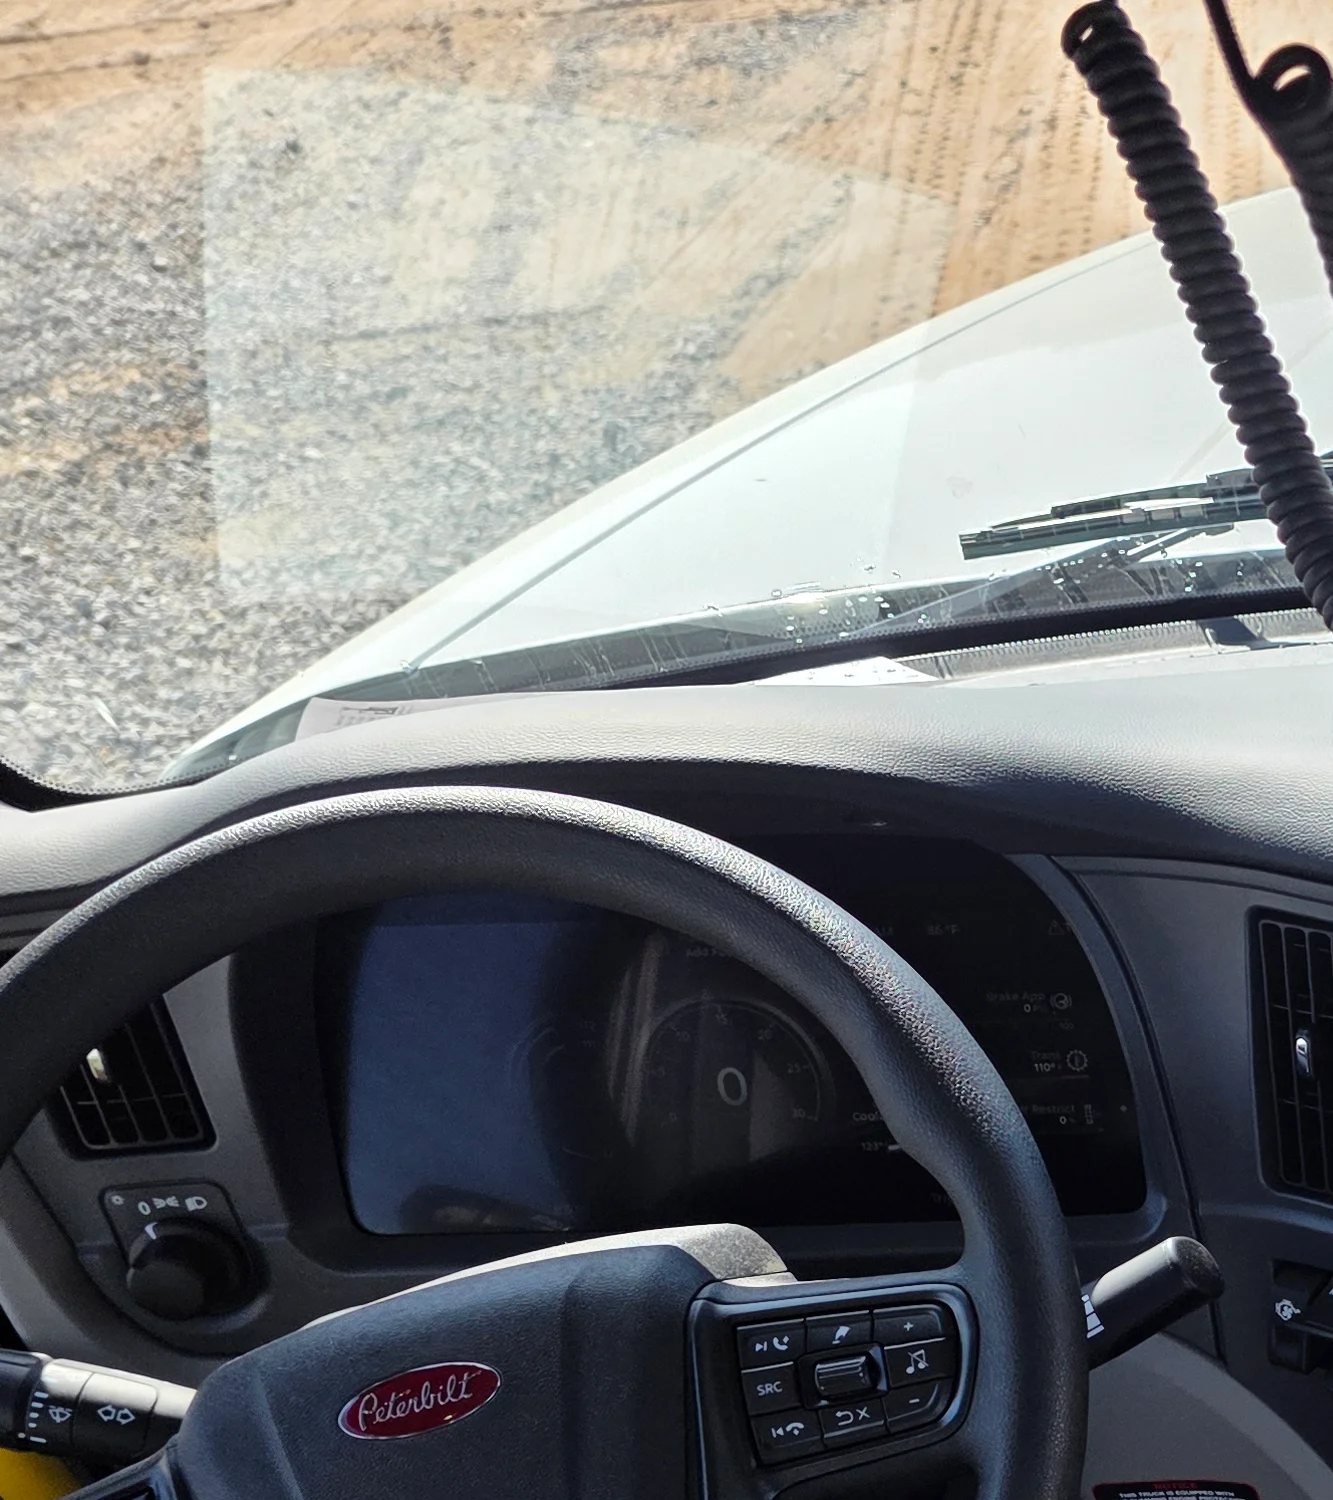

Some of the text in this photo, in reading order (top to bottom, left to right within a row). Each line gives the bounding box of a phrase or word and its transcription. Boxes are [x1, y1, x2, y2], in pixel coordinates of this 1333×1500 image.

[717, 1067, 748, 1106] 0
[358, 1370, 483, 1432] Peterbilt
[755, 1380, 783, 1397] SRC
